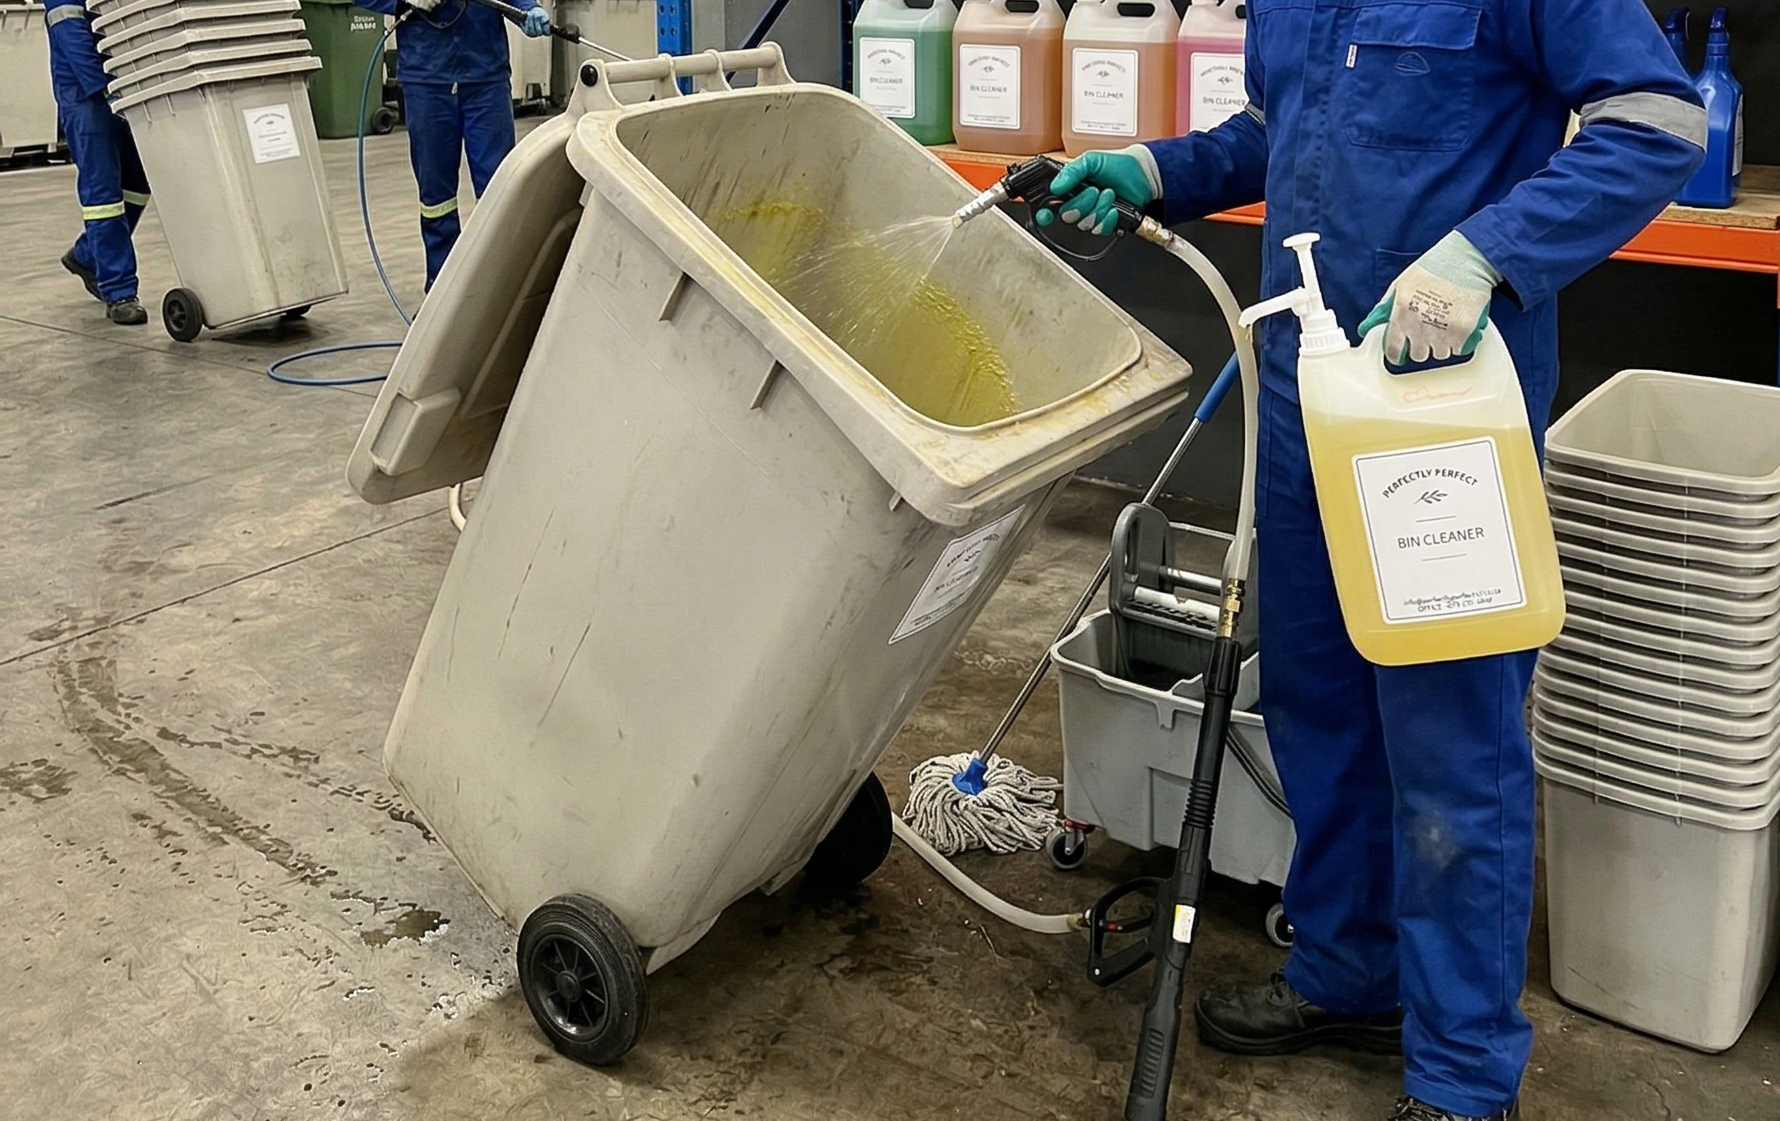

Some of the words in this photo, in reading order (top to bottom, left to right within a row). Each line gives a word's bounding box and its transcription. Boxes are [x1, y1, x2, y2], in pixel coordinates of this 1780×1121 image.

[1382, 469, 1432, 499] PERFECTLY
[1435, 468, 1478, 487] PERFECT
[1397, 536, 1421, 549] BIN
[1423, 527, 1485, 546] CLEANER
